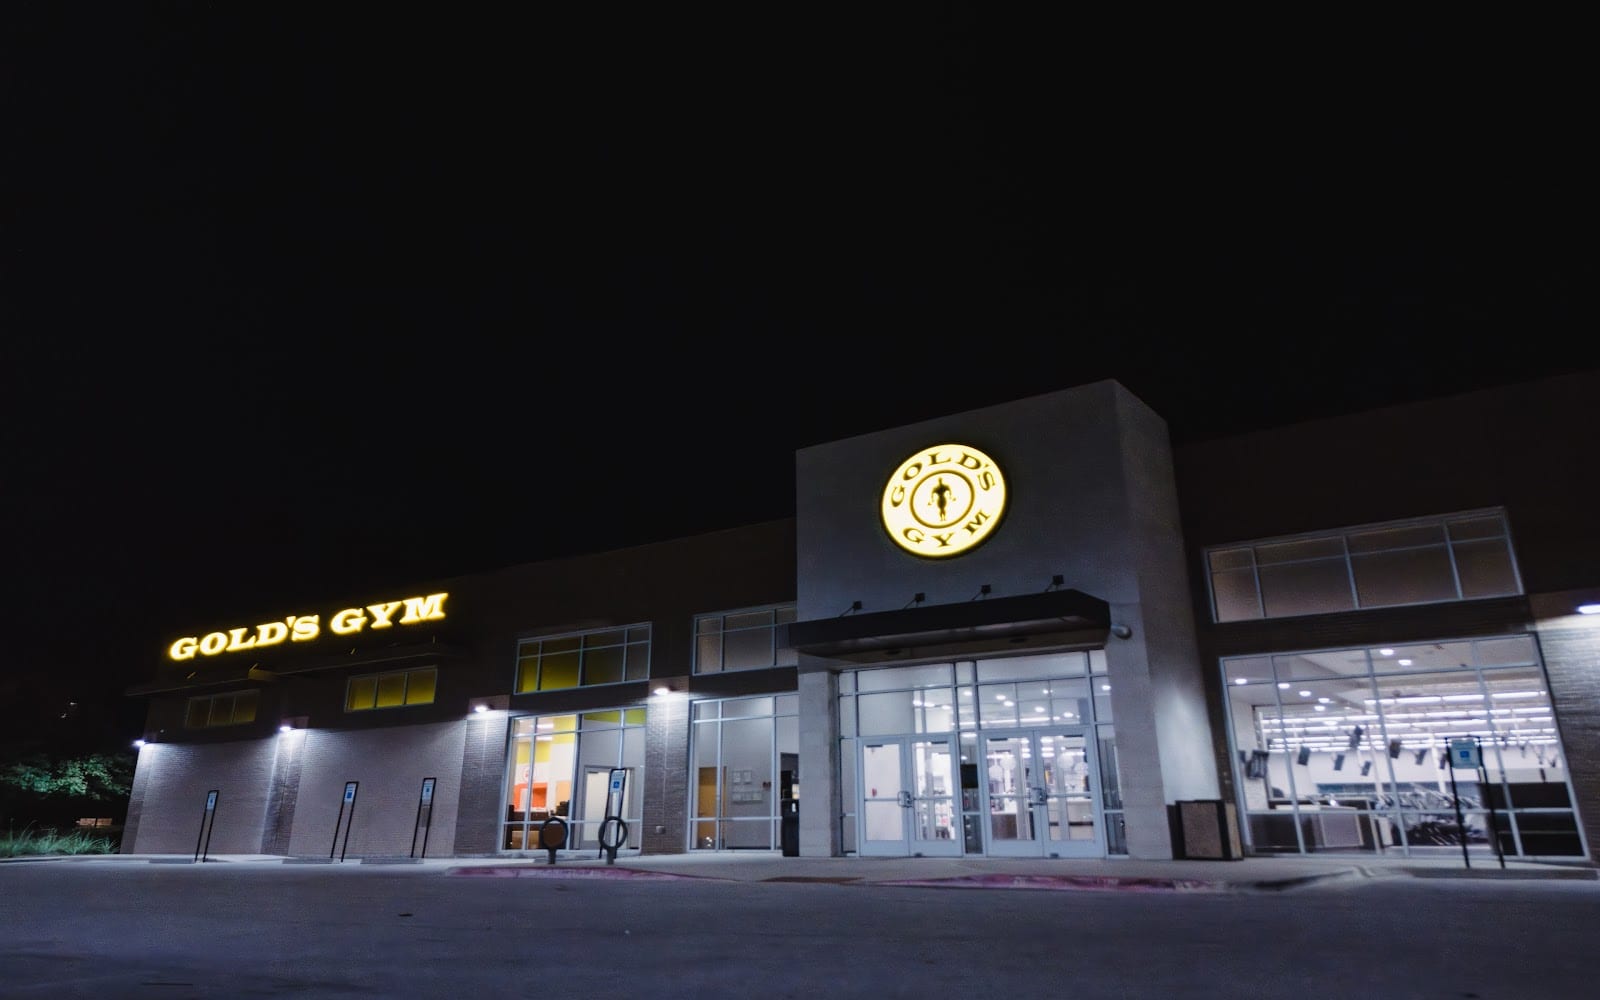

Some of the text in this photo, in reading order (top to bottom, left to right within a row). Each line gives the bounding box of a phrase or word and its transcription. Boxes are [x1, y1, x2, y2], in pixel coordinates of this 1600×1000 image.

[891, 452, 996, 508] GOLD'S
[902, 510, 990, 547] GYM
[169, 592, 448, 660] GOLD'S GYM
